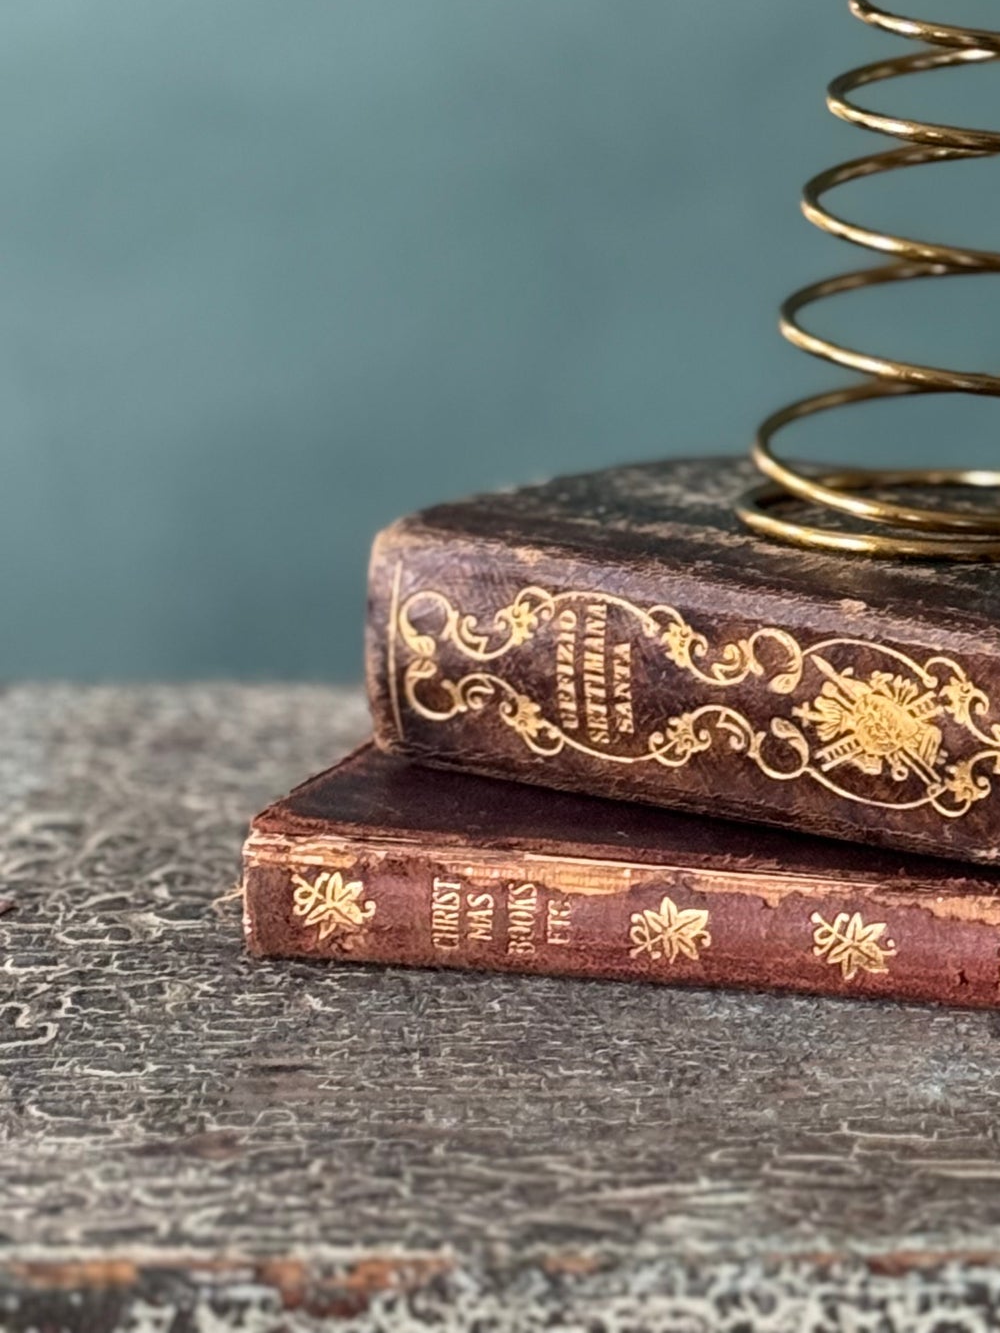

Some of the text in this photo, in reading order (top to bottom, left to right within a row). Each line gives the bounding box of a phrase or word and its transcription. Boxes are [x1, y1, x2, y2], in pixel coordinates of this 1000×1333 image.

[583, 604, 610, 744] SETTIMANA
[613, 642, 634, 734] SANTA
[432, 877, 461, 950] CHRIST
[466, 893, 494, 941] MAS
[507, 883, 538, 955] BOOKS
